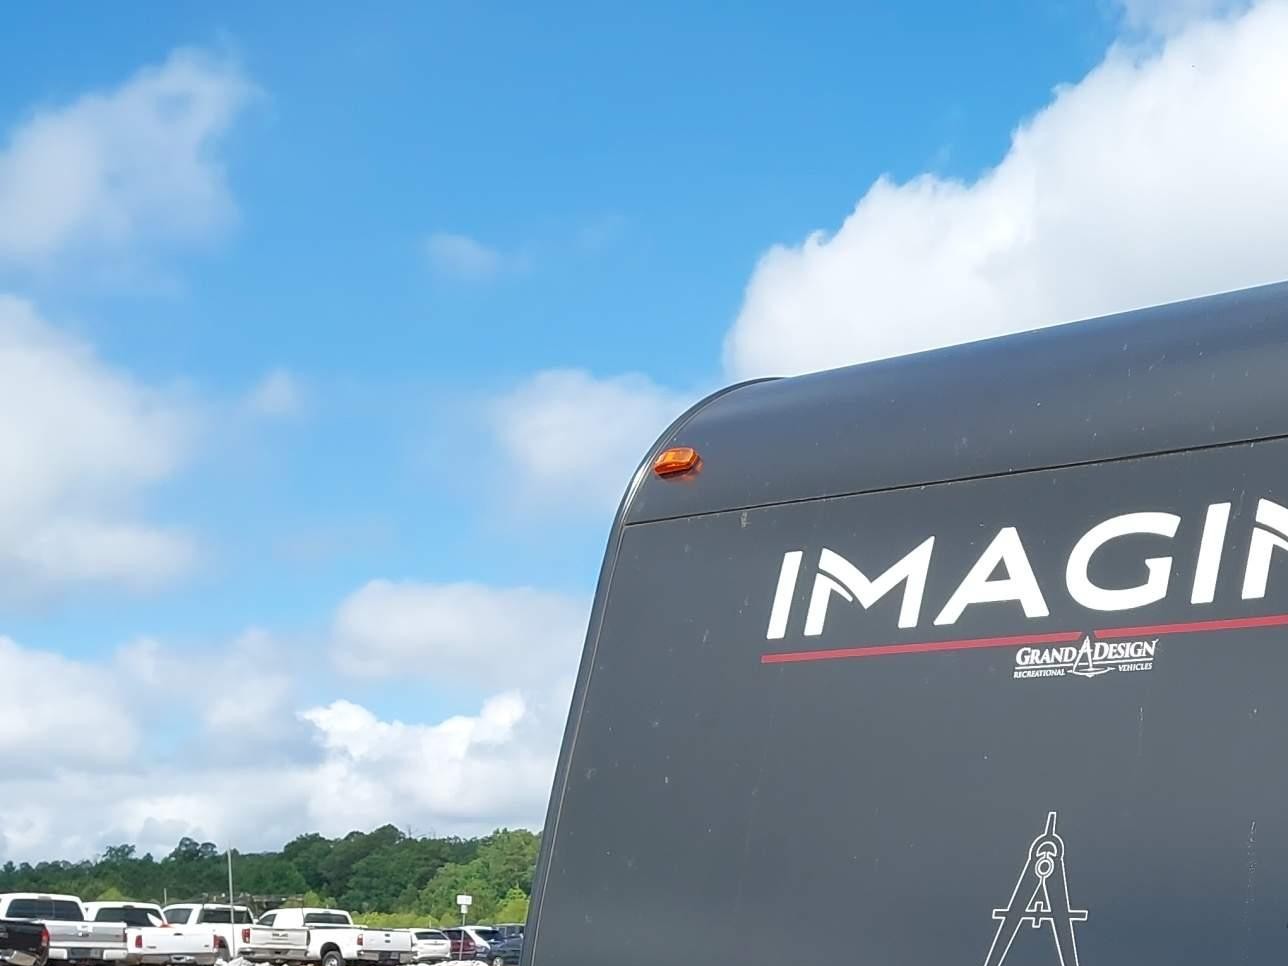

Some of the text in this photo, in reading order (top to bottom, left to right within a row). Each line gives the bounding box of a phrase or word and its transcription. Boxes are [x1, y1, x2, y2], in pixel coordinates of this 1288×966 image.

[1015, 640, 1158, 666] GRAND DESIGN
[1013, 662, 1153, 679] RECREATIONAL VEHICLES
